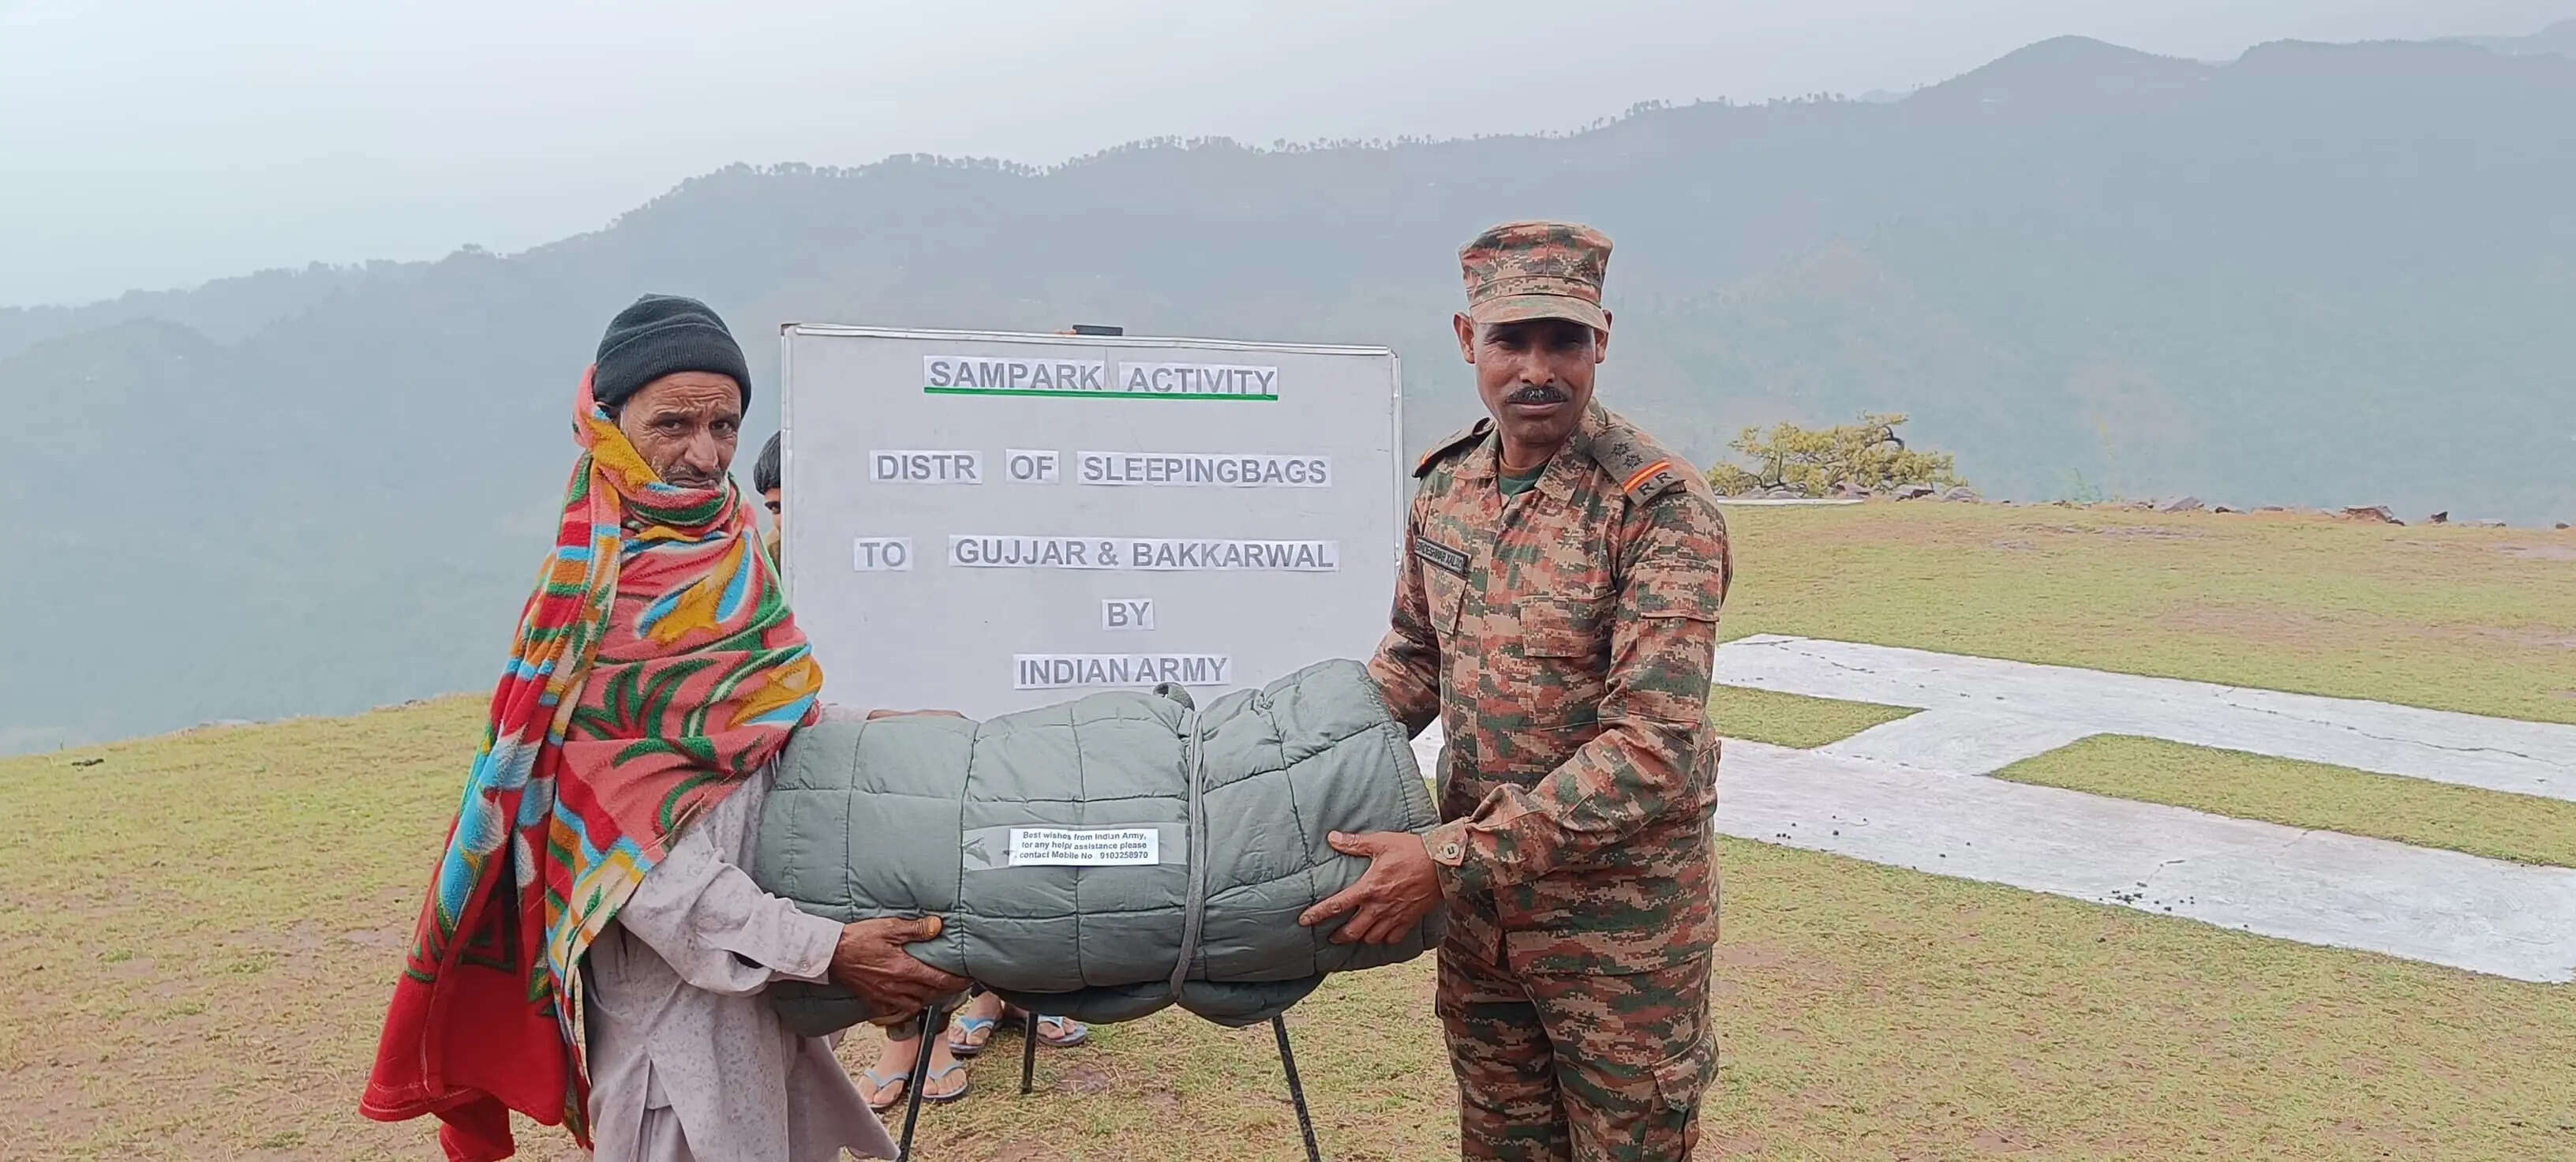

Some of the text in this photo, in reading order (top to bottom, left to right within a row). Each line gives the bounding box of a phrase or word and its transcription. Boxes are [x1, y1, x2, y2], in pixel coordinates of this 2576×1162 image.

[930, 361, 1275, 395] SAMPARK ACTIVITY
[876, 455, 1327, 485] DISTR OF SLEEPINGBAGS
[859, 538, 1334, 568] TO GUJJAR & BAKKARWAL
[1106, 602, 1150, 626] BY
[1019, 656, 1228, 685] INDIAN ARMY
[1035, 842, 1050, 850] any
[1120, 842, 1147, 850] please
[1043, 832, 1072, 841] wishes
[1051, 851, 1079, 860] Mobile
